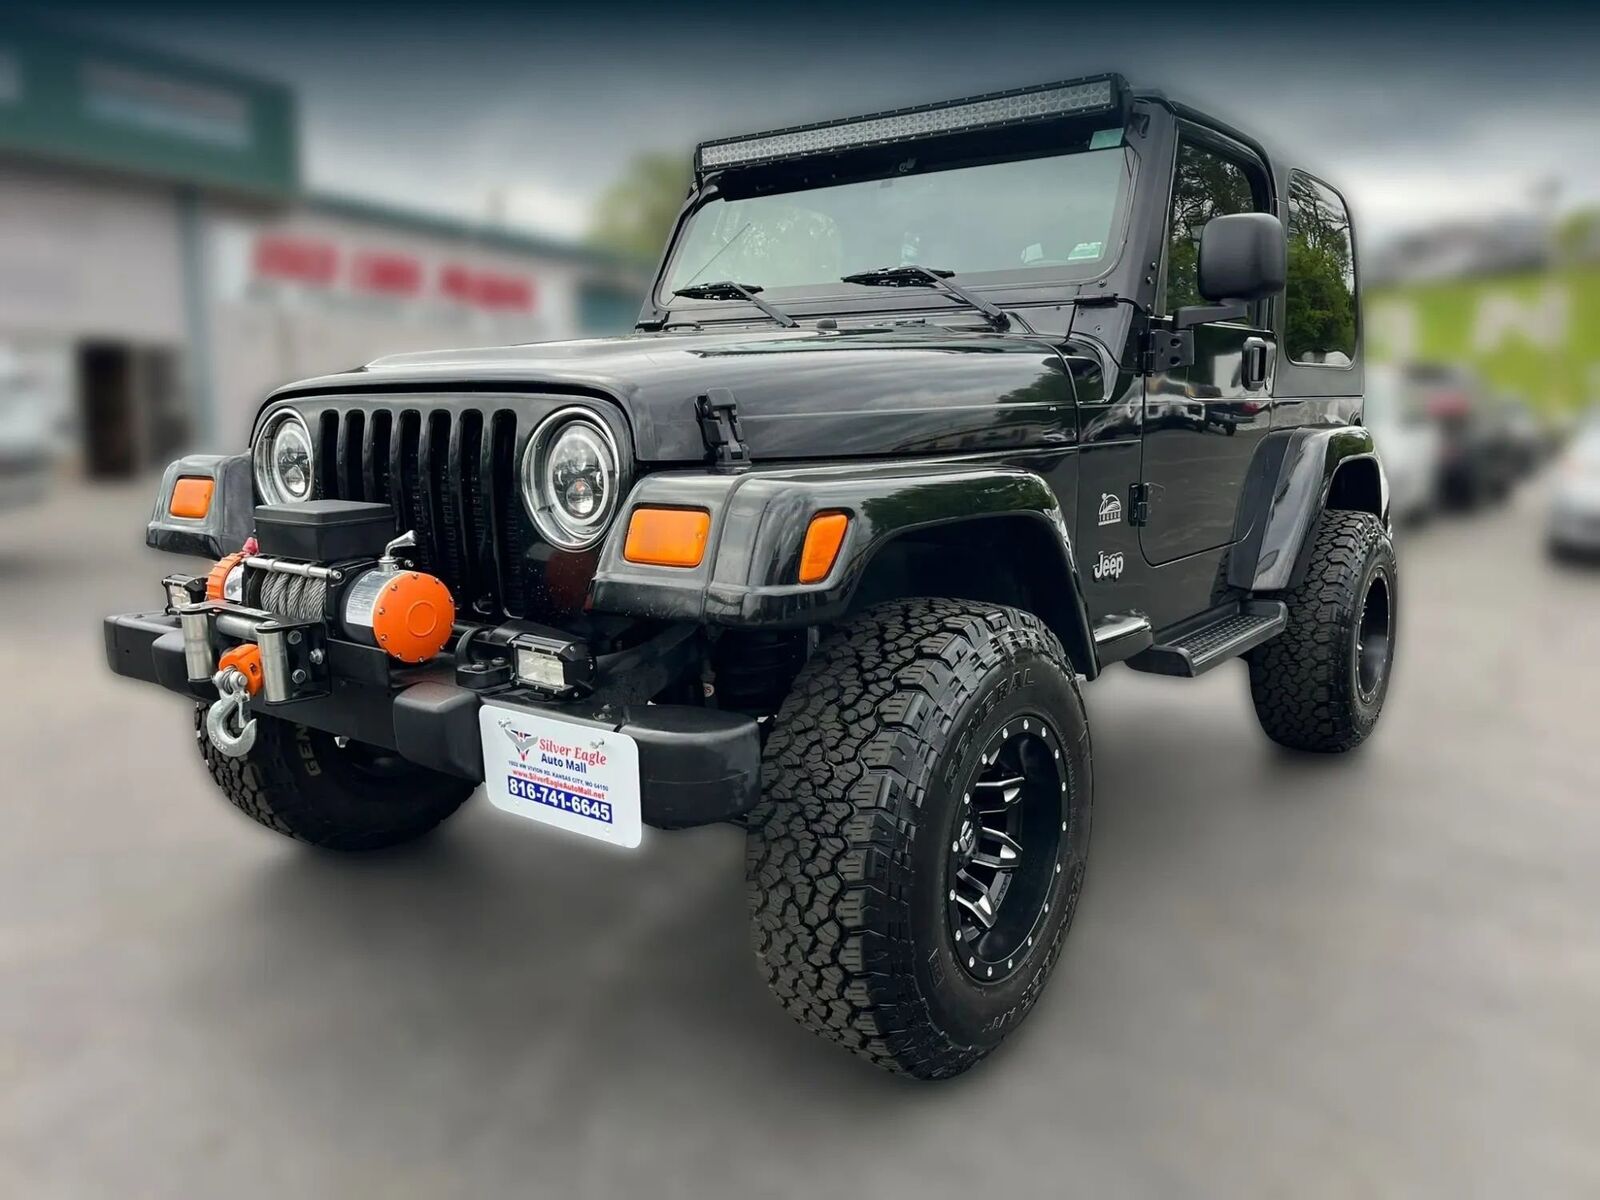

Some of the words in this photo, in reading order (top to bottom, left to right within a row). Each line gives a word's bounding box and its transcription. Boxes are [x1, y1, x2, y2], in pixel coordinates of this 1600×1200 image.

[1093, 551, 1124, 579] Jeep
[944, 668, 1035, 793] GENERAL
[539, 738, 571, 757] Silver
[574, 746, 607, 766] Eagle
[541, 752, 563, 767] Auto
[566, 758, 587, 773] Mall
[512, 770, 606, 800] www.SilverEagleAutoMall.net
[552, 772, 571, 781] KANSAS
[509, 778, 611, 821] 816-741-6645
